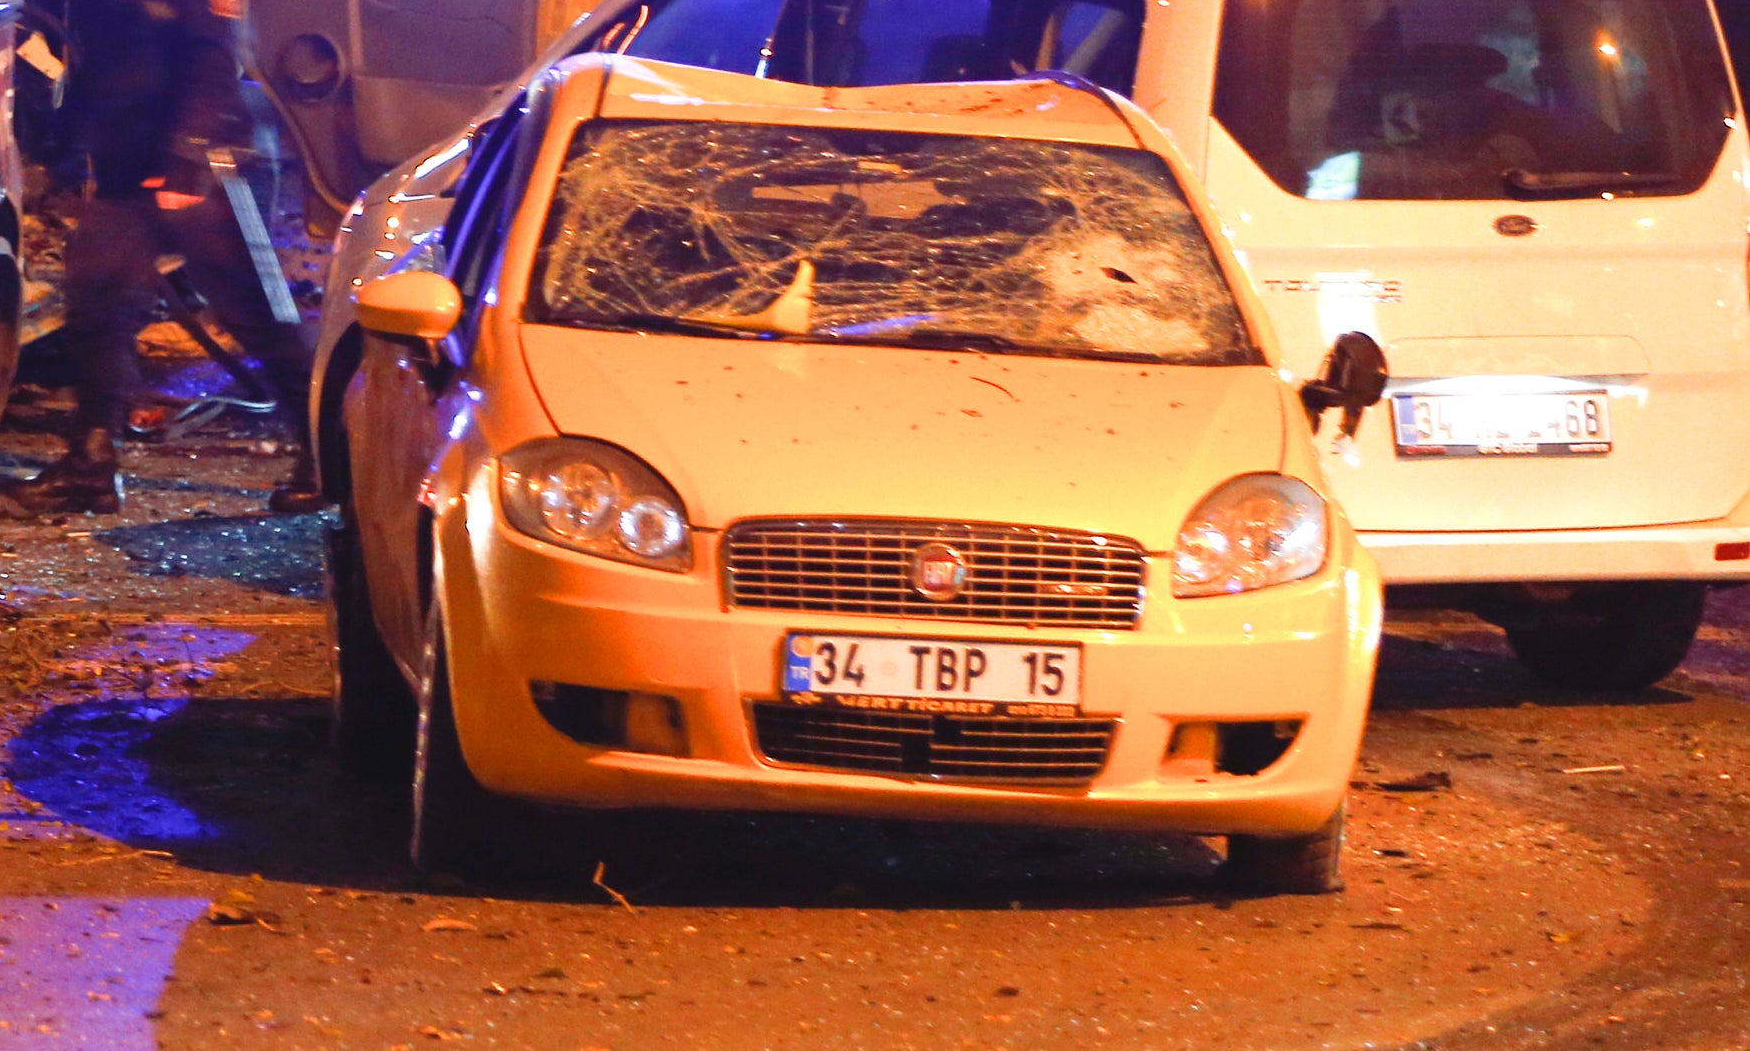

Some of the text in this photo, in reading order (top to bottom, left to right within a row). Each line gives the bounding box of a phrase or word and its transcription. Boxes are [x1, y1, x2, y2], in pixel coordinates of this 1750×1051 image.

[790, 666, 810, 680] TR
[815, 641, 1065, 696] 34 TBP 15
